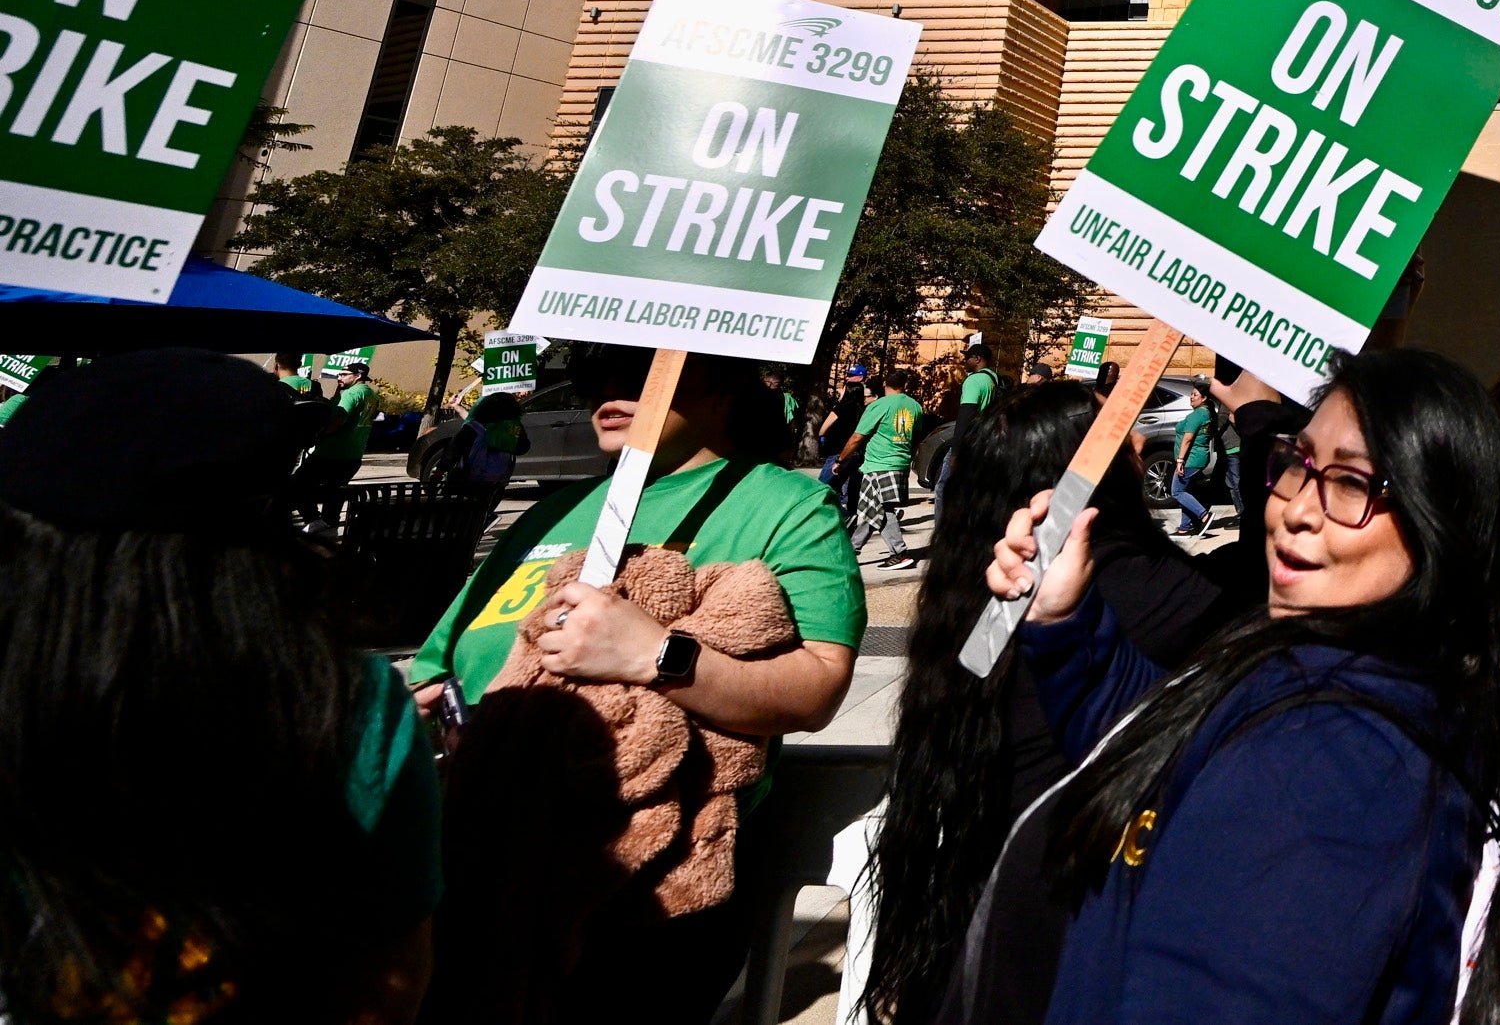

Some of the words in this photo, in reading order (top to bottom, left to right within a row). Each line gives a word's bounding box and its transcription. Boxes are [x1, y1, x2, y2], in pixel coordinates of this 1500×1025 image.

[806, 42, 893, 87] 3299
[1270, 0, 1404, 127] ON
[692, 101, 799, 178] ON
[1132, 64, 1423, 280] STRIKE
[578, 170, 844, 271] STRIKE
[1069, 203, 1152, 271] UNFAIR
[1148, 248, 1226, 314] LABOR
[489, 336, 515, 345] AFSCME
[517, 335, 533, 343] 3299
[538, 291, 622, 321] UNFAIR
[625, 300, 701, 330] LABOR
[702, 310, 809, 342] PRACTICE
[502, 350, 519, 364] ON
[1071, 349, 1101, 364] STRIKE
[1083, 337, 1096, 350] ON
[487, 363, 532, 380] STRIKE
